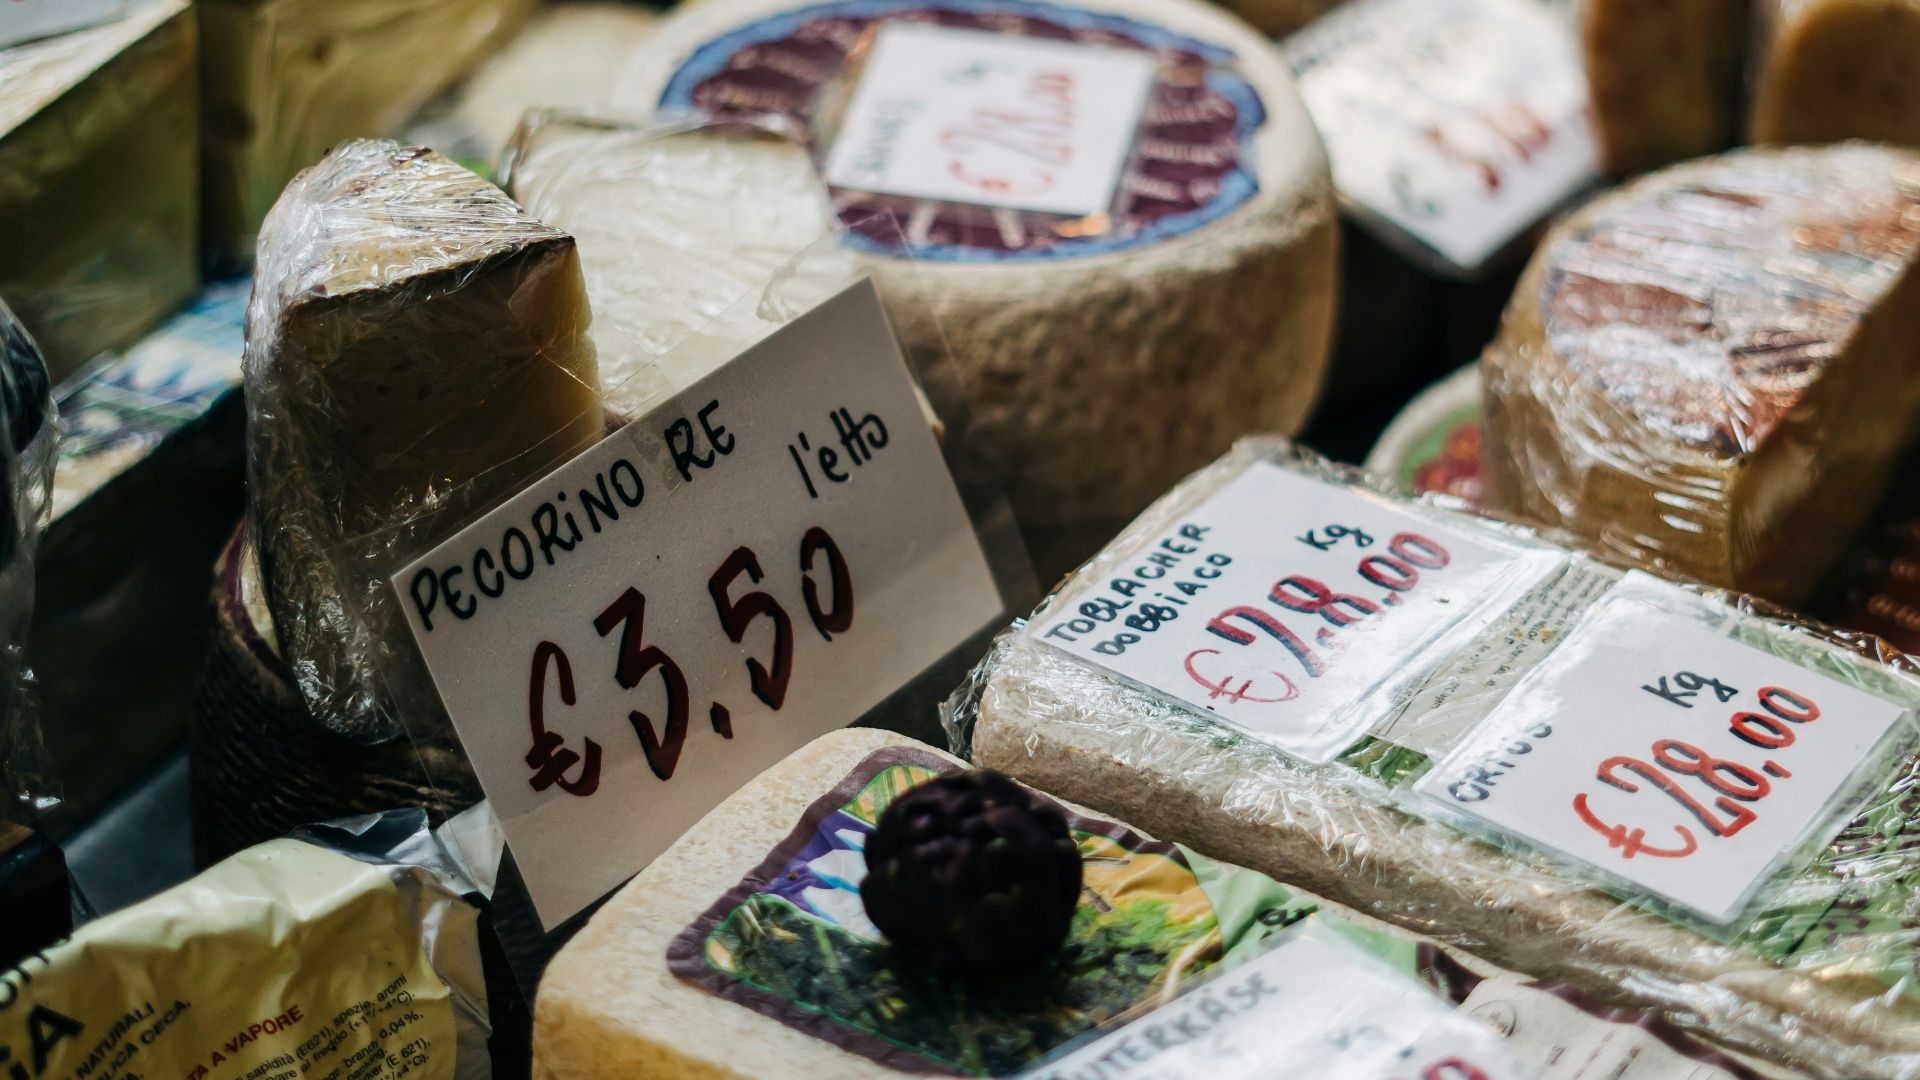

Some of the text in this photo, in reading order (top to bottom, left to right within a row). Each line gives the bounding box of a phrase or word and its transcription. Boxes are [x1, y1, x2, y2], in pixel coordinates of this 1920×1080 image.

[664, 399, 736, 483] RE
[376, 973, 408, 1002] aromi
[75, 1002, 156, 1079] NATURALI
[211, 1050, 227, 1068] A
[224, 1004, 304, 1054] VAPORE
